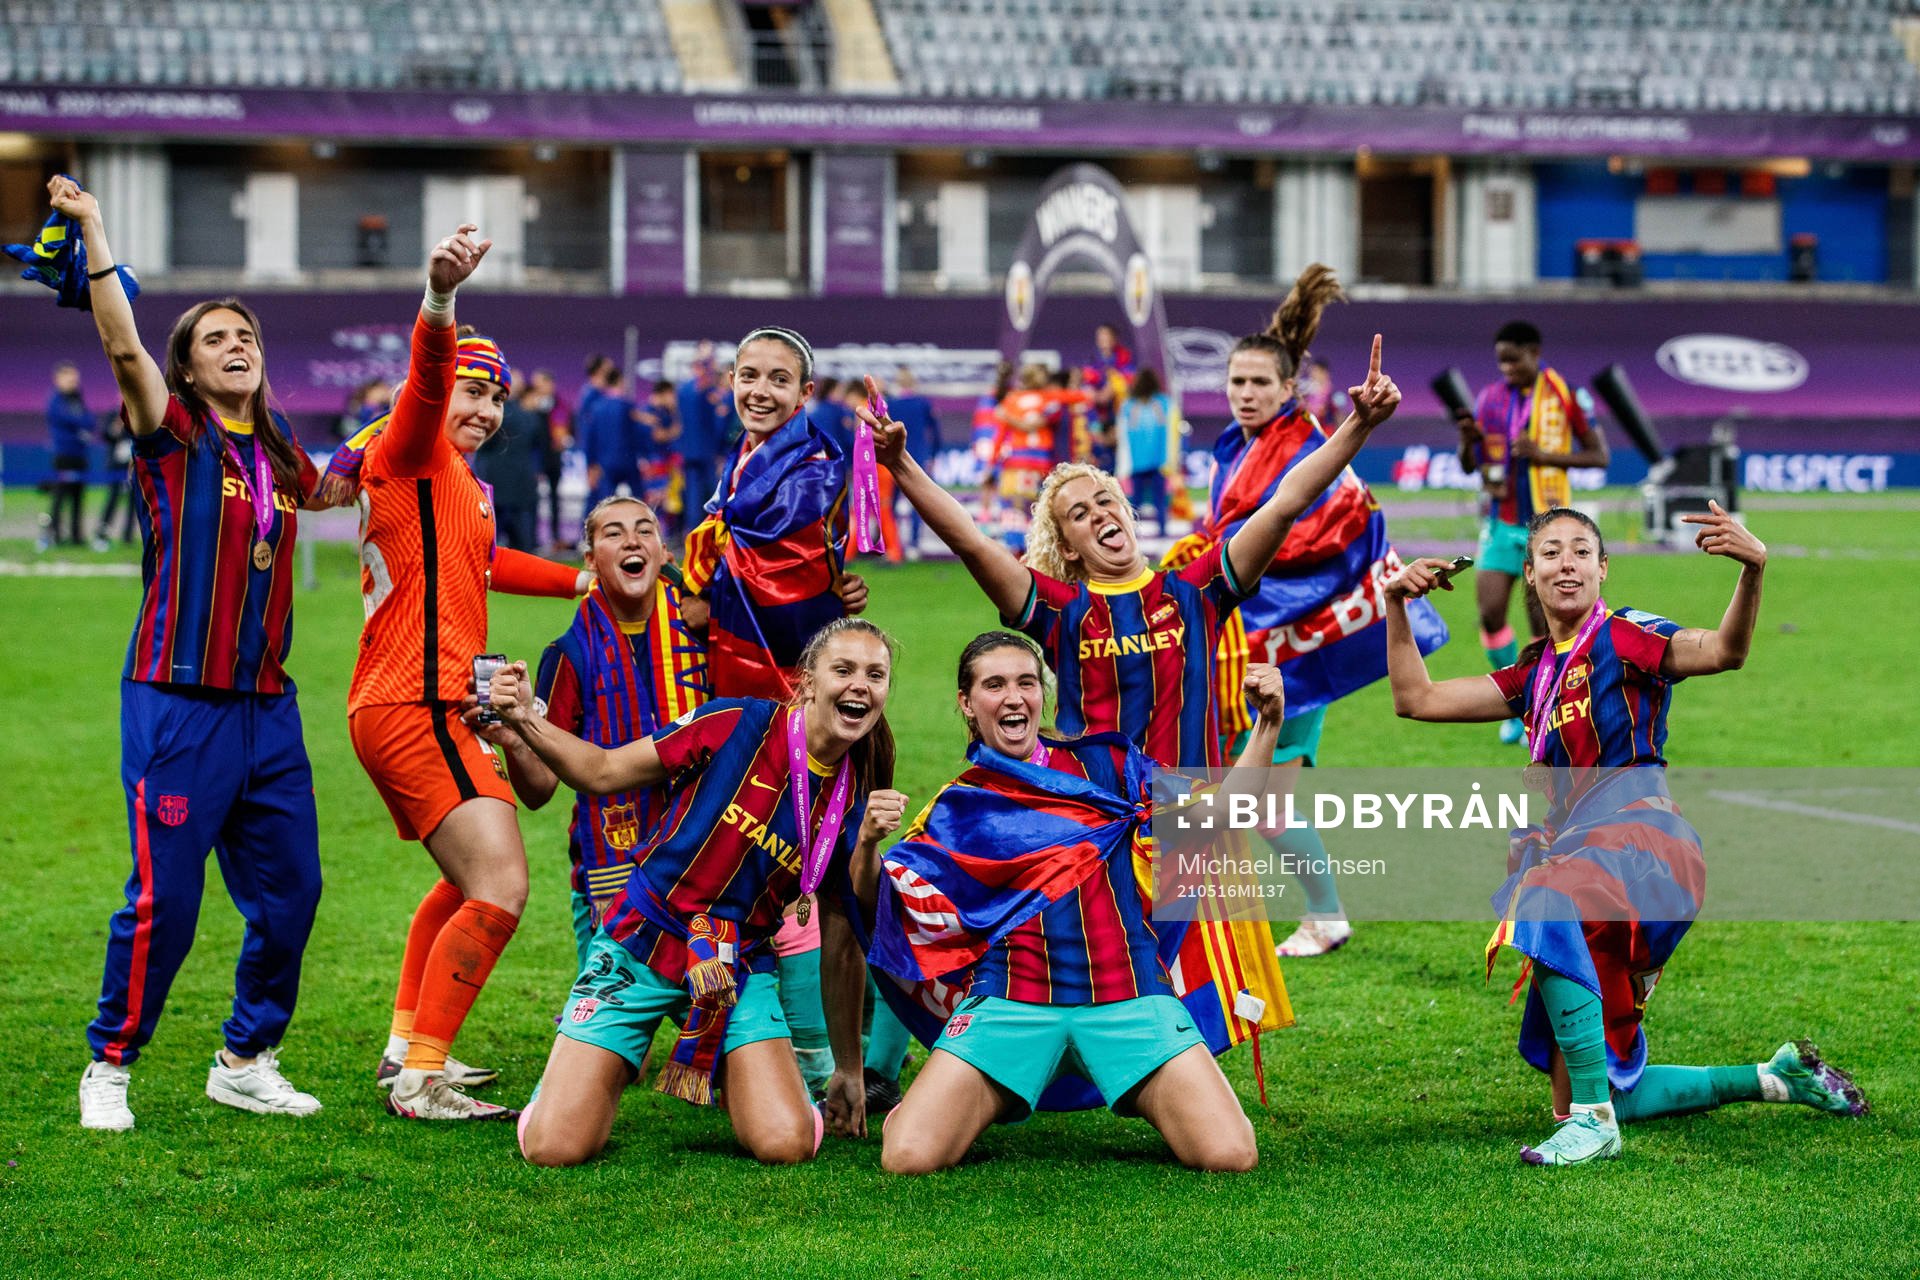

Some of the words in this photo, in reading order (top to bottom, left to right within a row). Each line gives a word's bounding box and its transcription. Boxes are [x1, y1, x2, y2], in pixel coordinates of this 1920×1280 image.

[1745, 454, 1894, 493] RESPECT
[1078, 626, 1186, 661] STANLEY
[722, 803, 802, 876] STANLE
